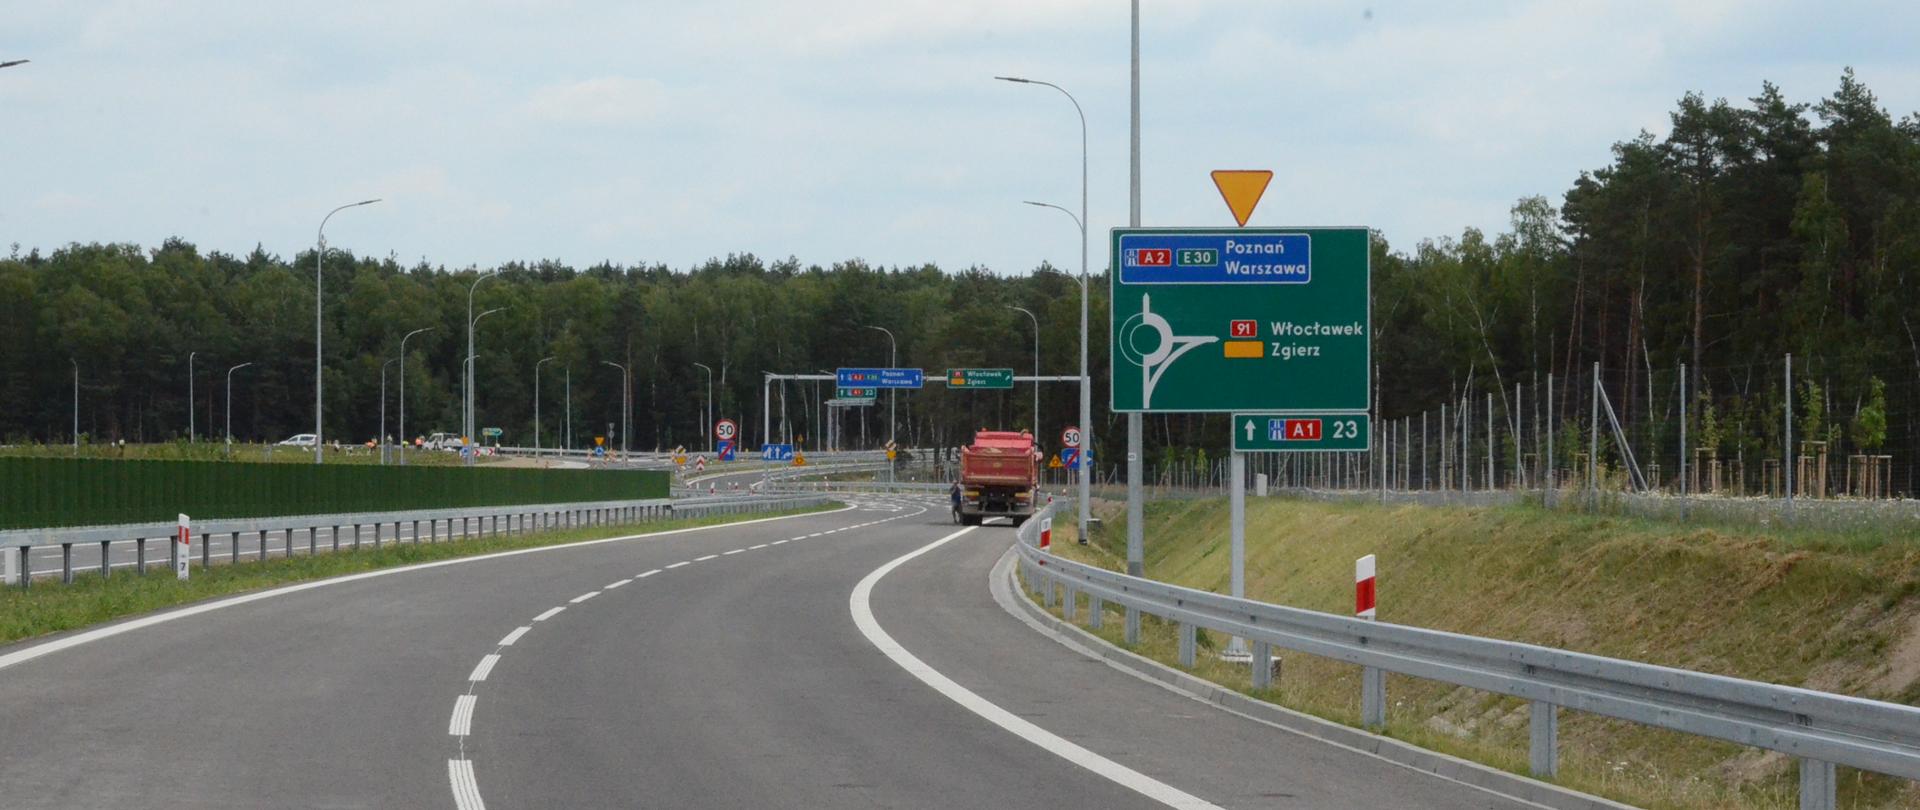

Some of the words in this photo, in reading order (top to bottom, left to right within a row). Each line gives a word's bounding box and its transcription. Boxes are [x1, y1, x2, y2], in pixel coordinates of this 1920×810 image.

[1225, 239, 1284, 255] Poznań
[1225, 262, 1306, 275] Warszawa
[1237, 324, 1250, 335] 91
[1271, 322, 1363, 336] Włocławek
[1271, 343, 1320, 360] Zgierz
[719, 425, 733, 435] 50
[1333, 421, 1358, 438] 23
[1065, 433, 1079, 443] 50
